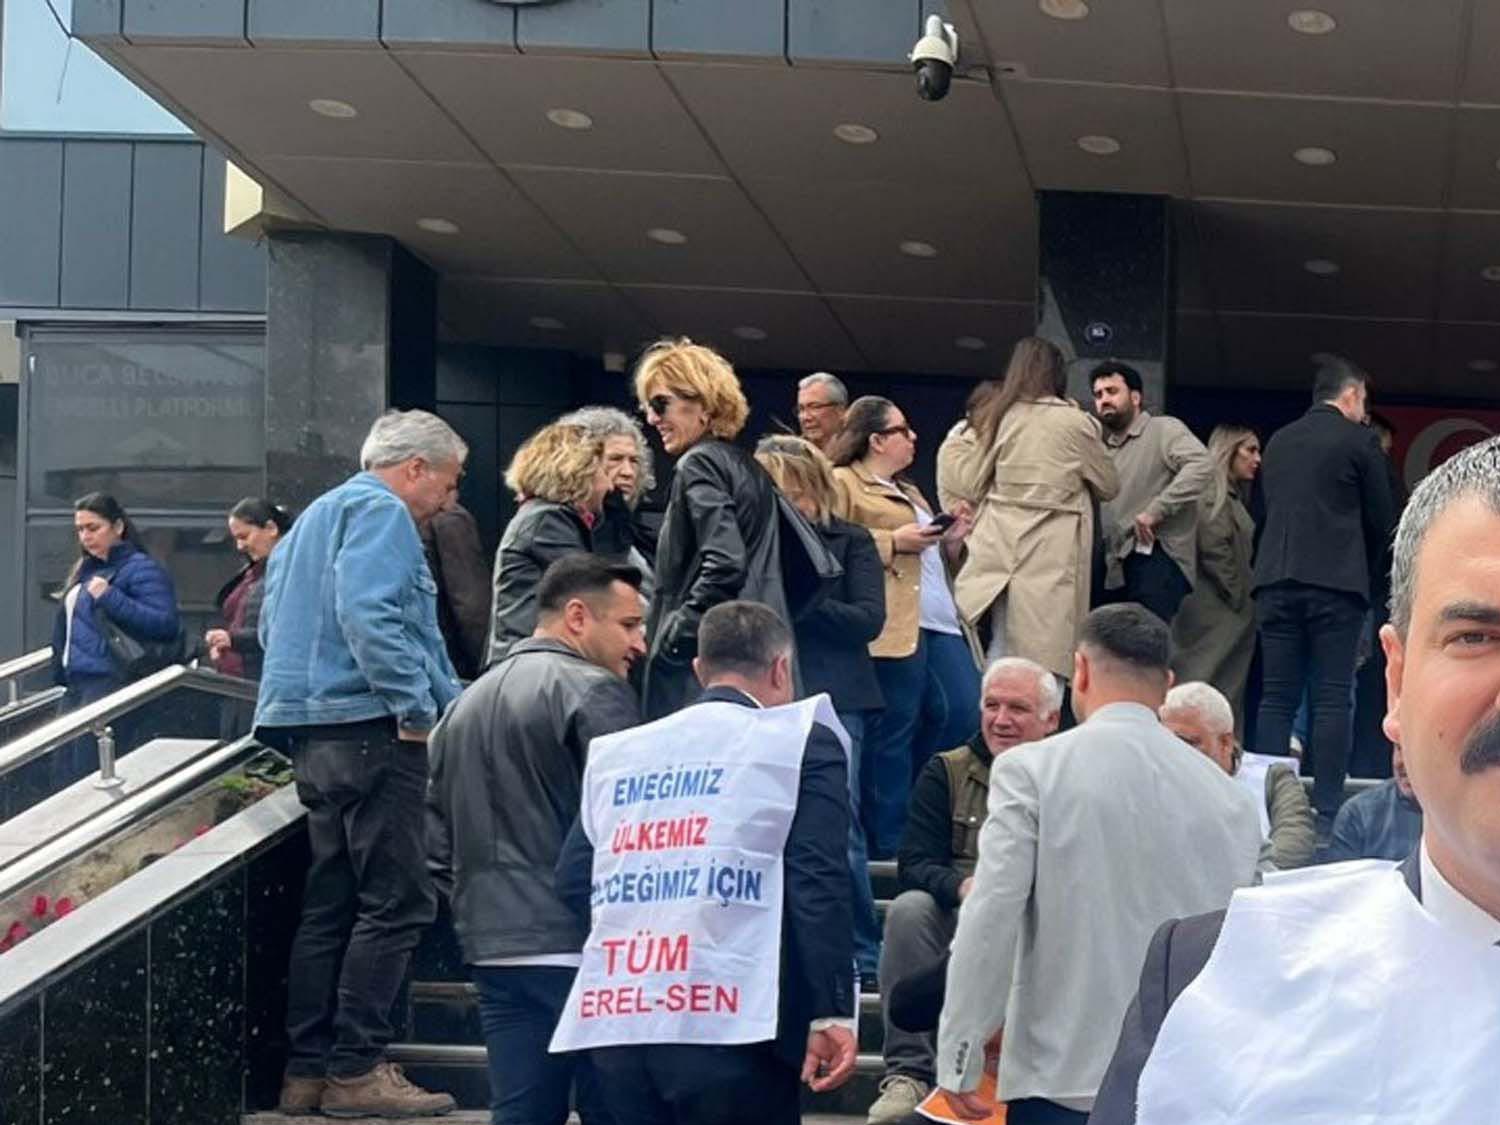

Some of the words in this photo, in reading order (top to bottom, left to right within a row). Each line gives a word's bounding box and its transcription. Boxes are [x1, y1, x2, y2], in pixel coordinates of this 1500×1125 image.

[612, 762, 725, 806] EMEĞİMİZ
[611, 811, 709, 855] ÜLKEMİZ
[707, 858, 762, 907] İÇİN
[602, 930, 690, 977] TÜM
